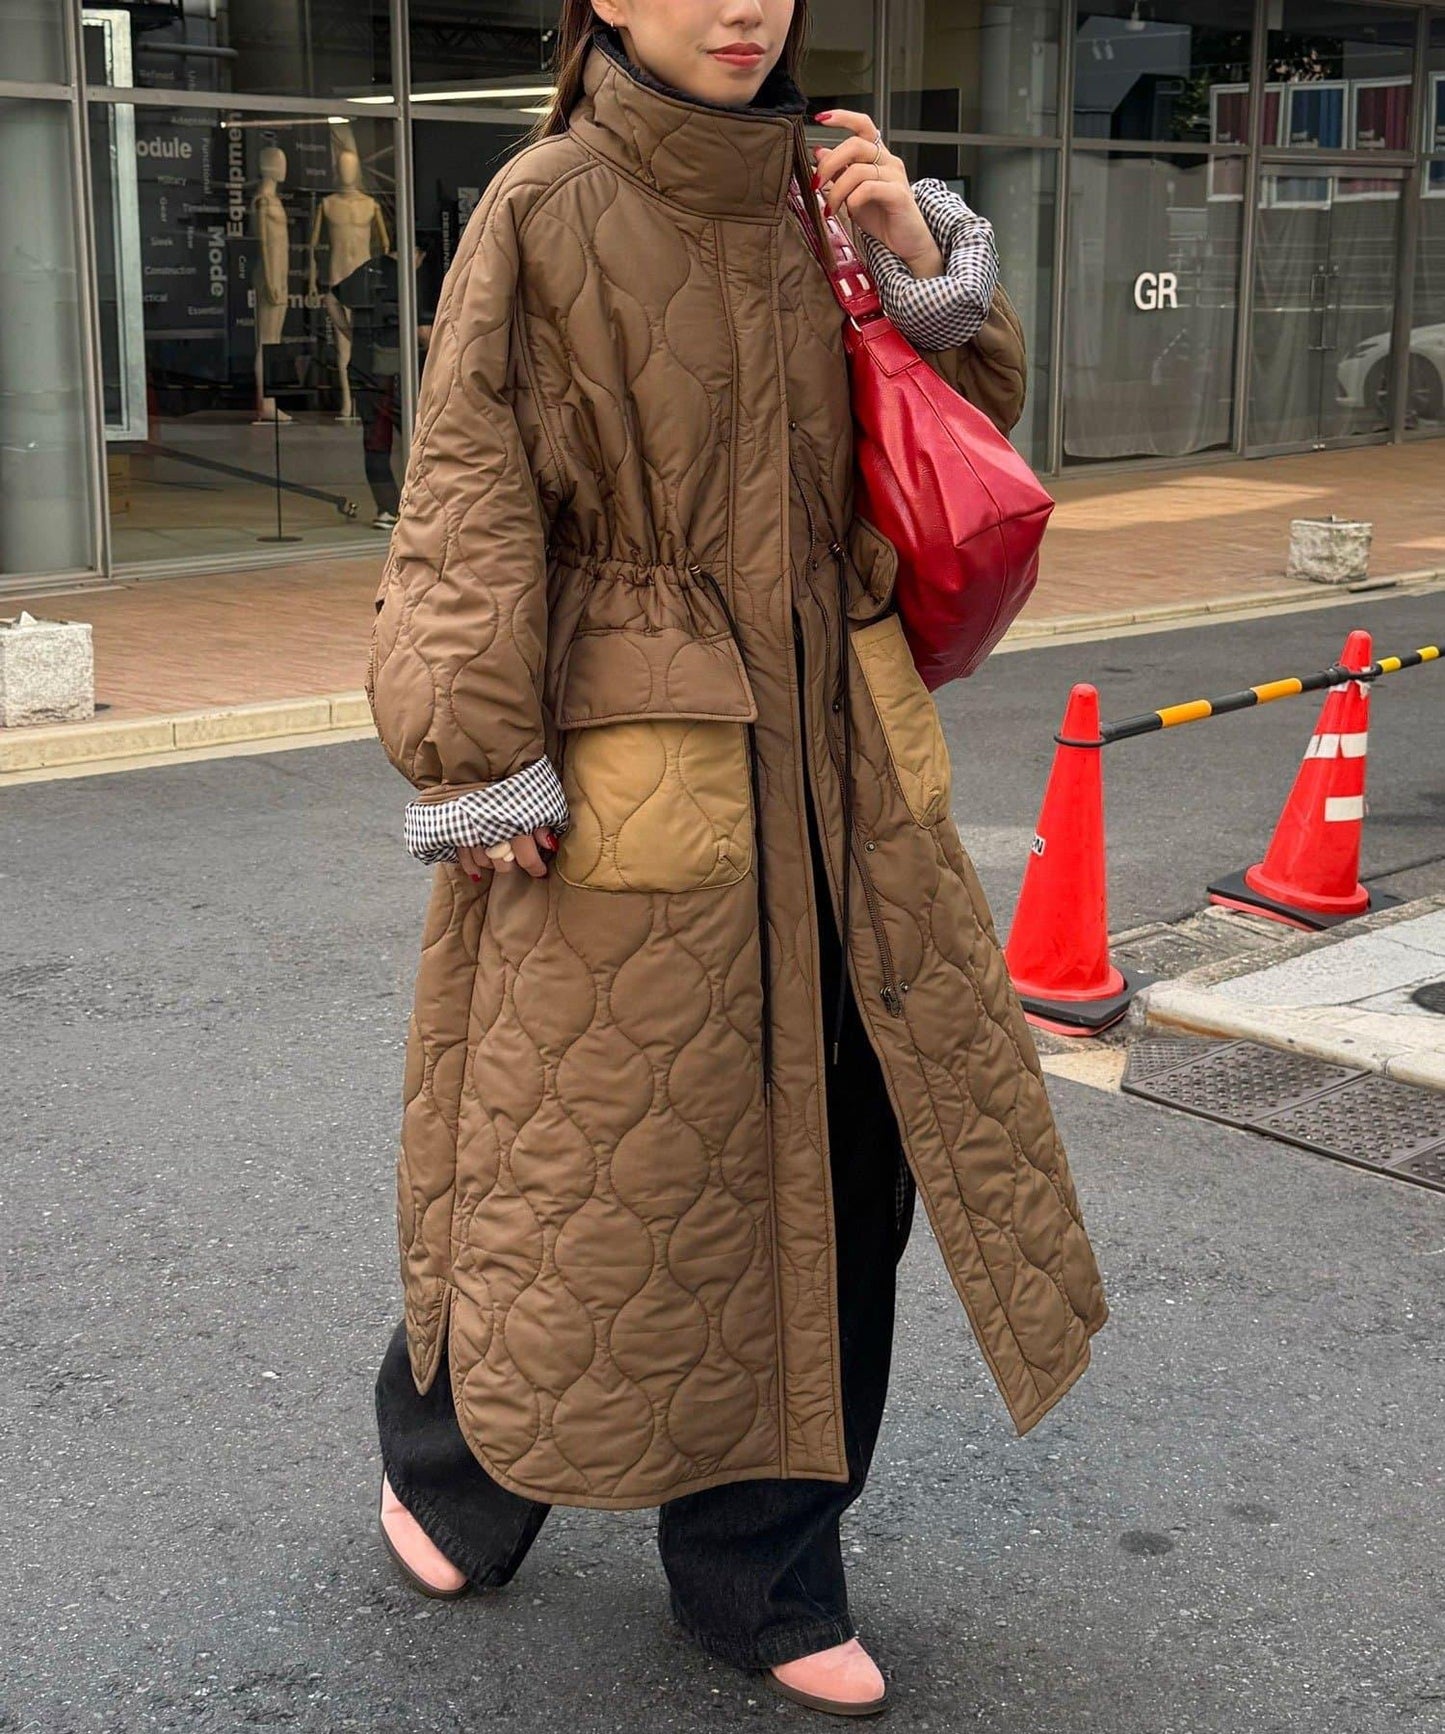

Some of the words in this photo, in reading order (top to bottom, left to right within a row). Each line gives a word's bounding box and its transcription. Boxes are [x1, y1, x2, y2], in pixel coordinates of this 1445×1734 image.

[137, 136, 193, 159] odule
[225, 112, 246, 237] Equipmen
[208, 226, 227, 297] Mode
[1134, 272, 1178, 310] GR
